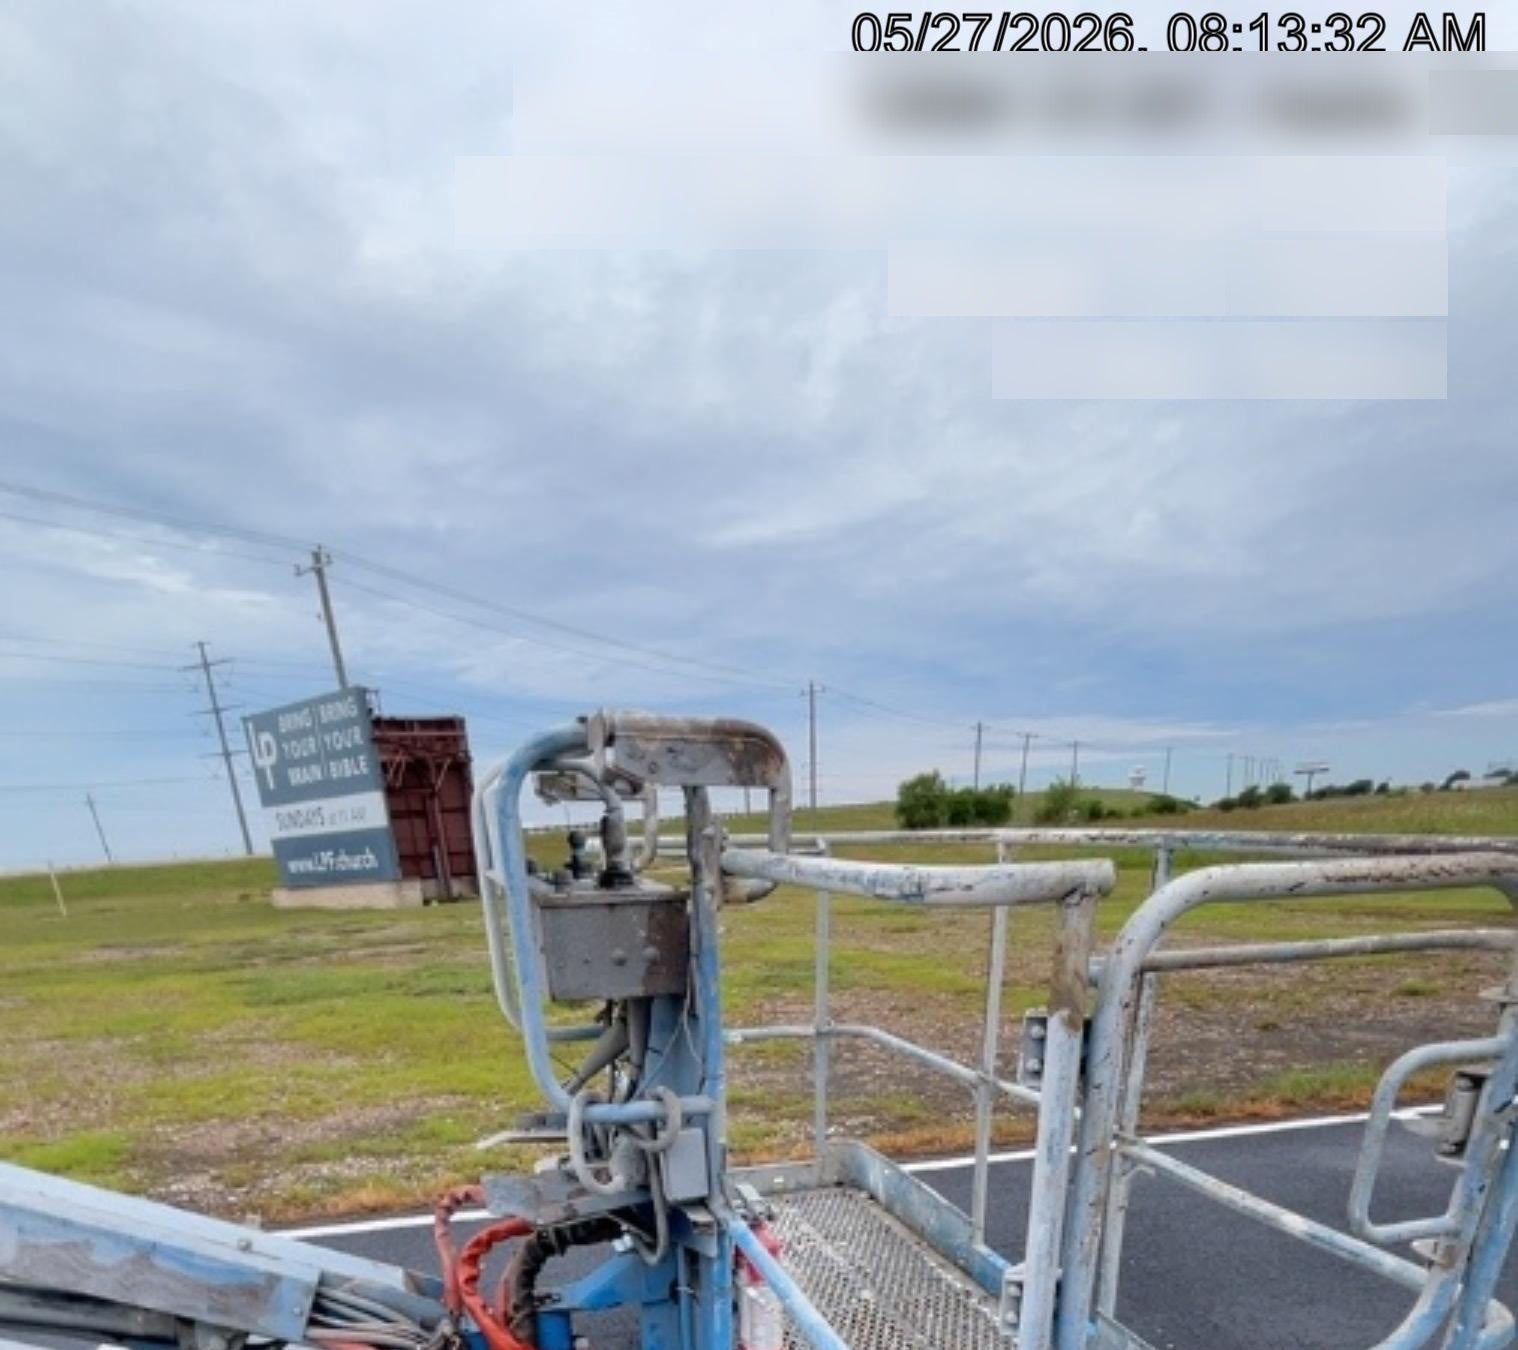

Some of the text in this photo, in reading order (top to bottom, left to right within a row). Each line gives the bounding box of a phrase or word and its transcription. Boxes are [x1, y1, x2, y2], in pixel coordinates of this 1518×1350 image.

[281, 736, 316, 759] YOUR
[322, 726, 364, 750] YOUR
[328, 755, 368, 779] BIBLE
